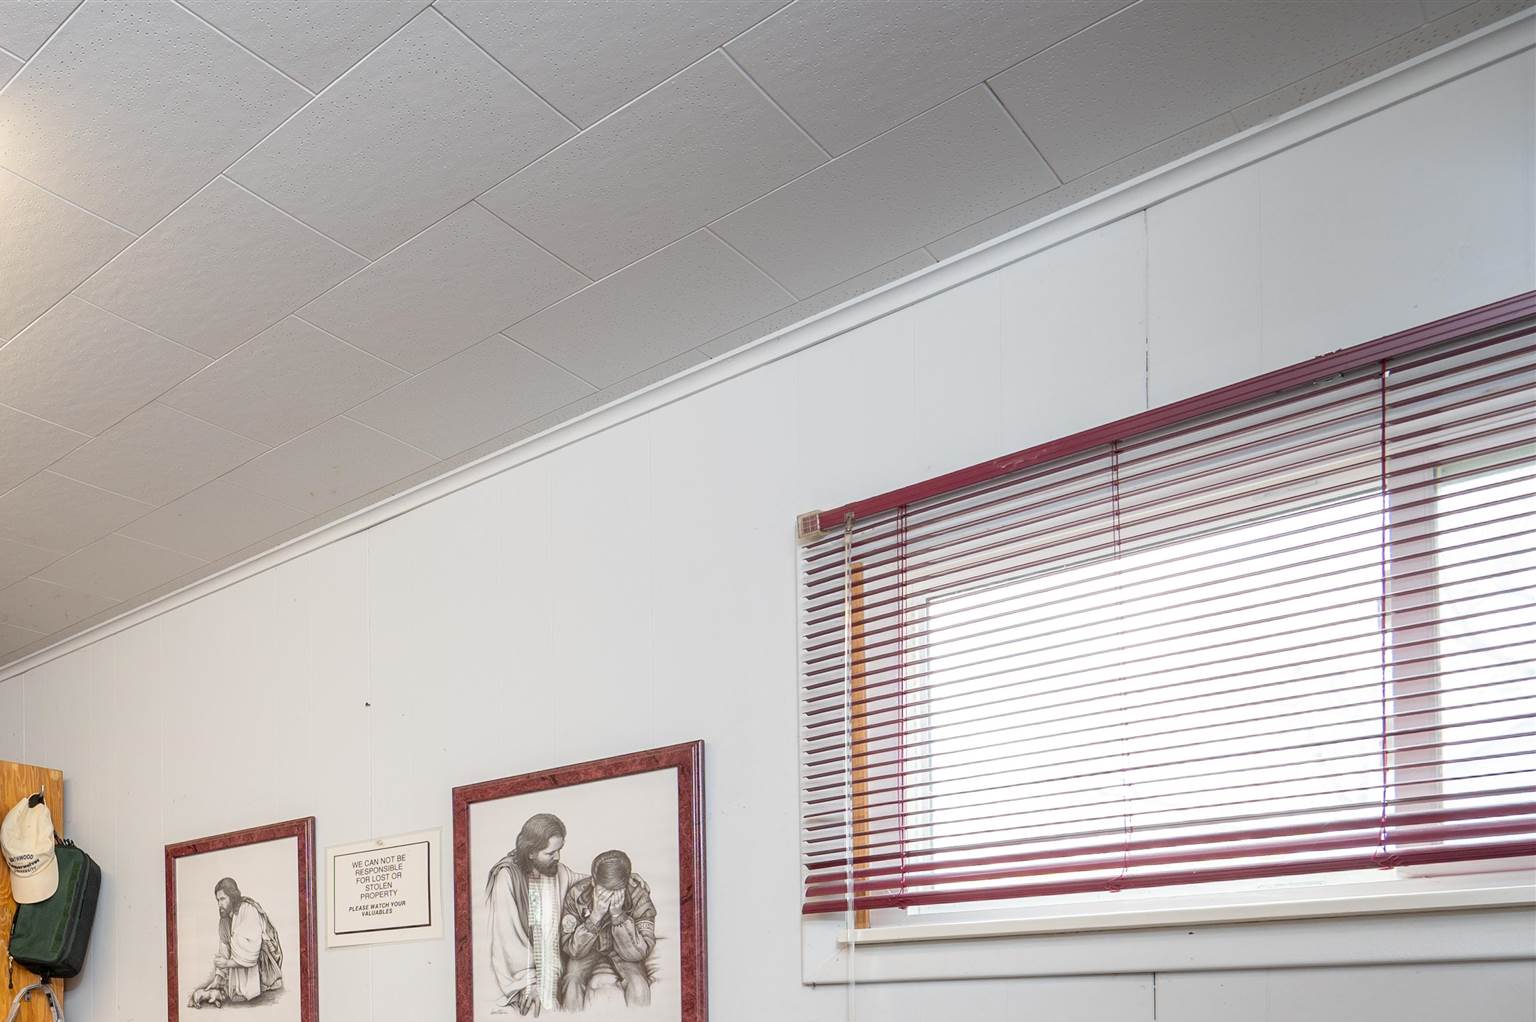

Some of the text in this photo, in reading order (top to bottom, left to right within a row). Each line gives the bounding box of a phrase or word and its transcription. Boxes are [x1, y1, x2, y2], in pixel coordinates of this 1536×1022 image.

[364, 858, 379, 866] CAN
[380, 856, 395, 865] NOT
[355, 863, 403, 876] RESPONSIBLE
[356, 872, 402, 885] FOR LOST OR
[365, 882, 393, 891] STOLEN
[360, 890, 398, 900] PROPERTY
[361, 909, 393, 917] VALUABLES
